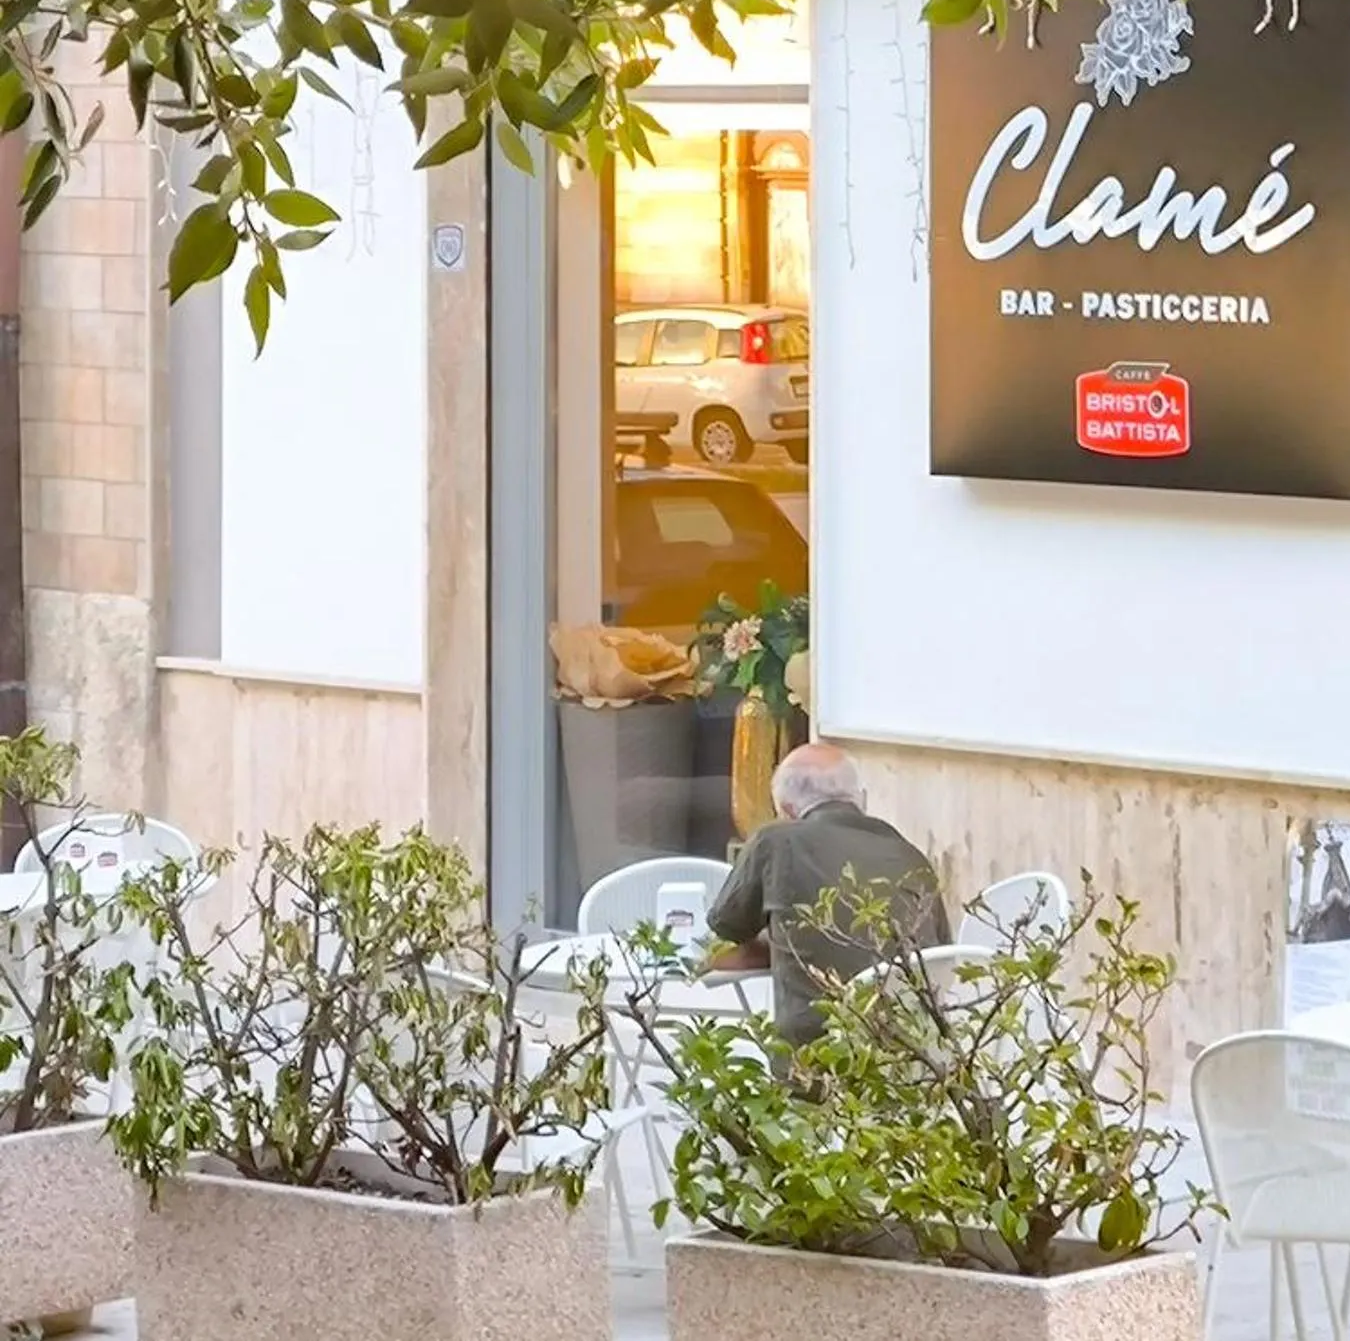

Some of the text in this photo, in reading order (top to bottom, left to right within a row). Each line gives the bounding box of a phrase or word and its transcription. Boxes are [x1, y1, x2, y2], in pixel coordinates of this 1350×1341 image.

[962, 101, 1316, 260] Clamé
[1000, 289, 1055, 315] BAR
[1081, 291, 1270, 325] PASTICCERIA
[1086, 390, 1181, 418] BRISTOL
[1086, 420, 1181, 443] BATTISTA
